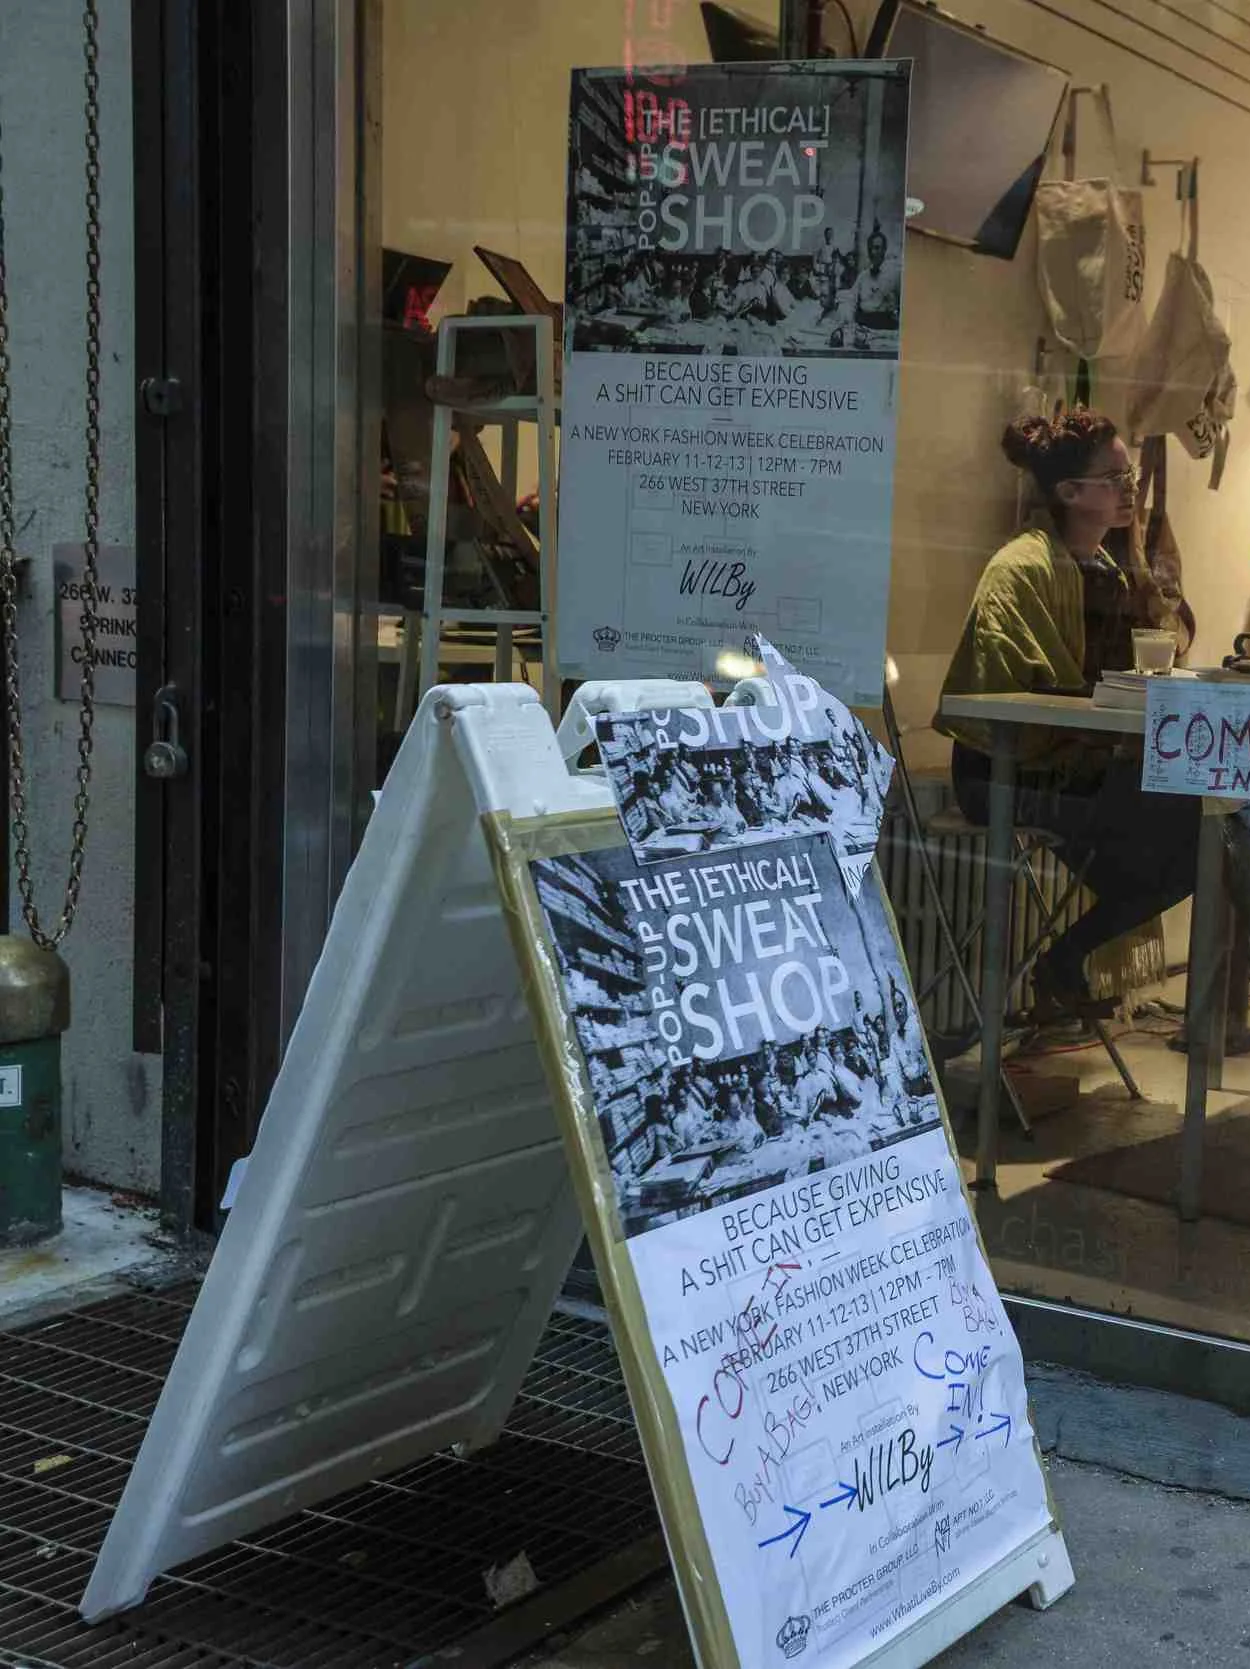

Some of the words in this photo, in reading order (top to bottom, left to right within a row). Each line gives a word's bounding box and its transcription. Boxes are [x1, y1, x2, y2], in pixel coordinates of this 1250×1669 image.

[643, 109, 692, 135] THE
[700, 105, 830, 138] [ETHICAL]
[659, 140, 828, 190] SWEAT
[638, 143, 658, 250] POP-UP
[658, 193, 826, 251] SHOP
[597, 383, 610, 401] A
[615, 383, 656, 403] SHIT
[660, 385, 701, 405] CAN
[707, 386, 746, 407] GET
[752, 388, 859, 410] EXPENSIVE
[644, 361, 734, 383] BECAUSE
[739, 364, 808, 385] GIVING
[570, 426, 580, 439] A
[584, 426, 619, 440] NEW
[622, 427, 659, 443] YORK
[663, 429, 728, 446] FASHION
[732, 432, 774, 448] WEEK
[778, 433, 884, 453] CELEBRATION
[608, 449, 680, 465] FEBRUARY
[685, 453, 745, 471] 11-12-13
[758, 457, 796, 473] 12PM
[810, 459, 842, 475] 7PM
[639, 474, 665, 490] 266
[669, 476, 707, 493] WEST
[711, 478, 748, 496] 37TH
[752, 480, 807, 497] STREET
[682, 501, 716, 516] NEW
[719, 502, 760, 519] YORK
[620, 871, 691, 913] THE
[689, 853, 820, 907] [ETHICAL]
[667, 893, 829, 977] SWEAT
[638, 920, 691, 1066] POP-UP
[680, 955, 850, 1060] SHOP
[722, 1182, 824, 1242] BECAUSE
[828, 1155, 901, 1201] GIVING
[681, 1268, 700, 1296] A
[700, 1244, 747, 1286] SHIT
[752, 1225, 801, 1264] CAN
[804, 1207, 845, 1243] GET
[849, 1168, 948, 1227] EXPENSIVE
[663, 1345, 678, 1368] A
[680, 1321, 725, 1360] NEW
[726, 1301, 774, 1337] YORK
[776, 1270, 844, 1316] FASHION
[844, 1254, 889, 1284] WEEK
[890, 1216, 971, 1266] CELEBRATION
[721, 1321, 801, 1377] FEBRUARY
[807, 1293, 870, 1337] 11-12-13
[878, 1271, 923, 1303] 12PM
[934, 1254, 956, 1281] 7PM
[767, 1363, 797, 1395] 266
[799, 1340, 844, 1377] WEST
[846, 1323, 883, 1357] 37TH
[883, 1295, 940, 1337] STREET
[822, 1366, 862, 1402] NEW
[861, 1345, 904, 1380] YORK
[854, 1428, 935, 1513] WILBy
[813, 1600, 832, 1621] THE
[831, 1572, 875, 1609] PROCTER
